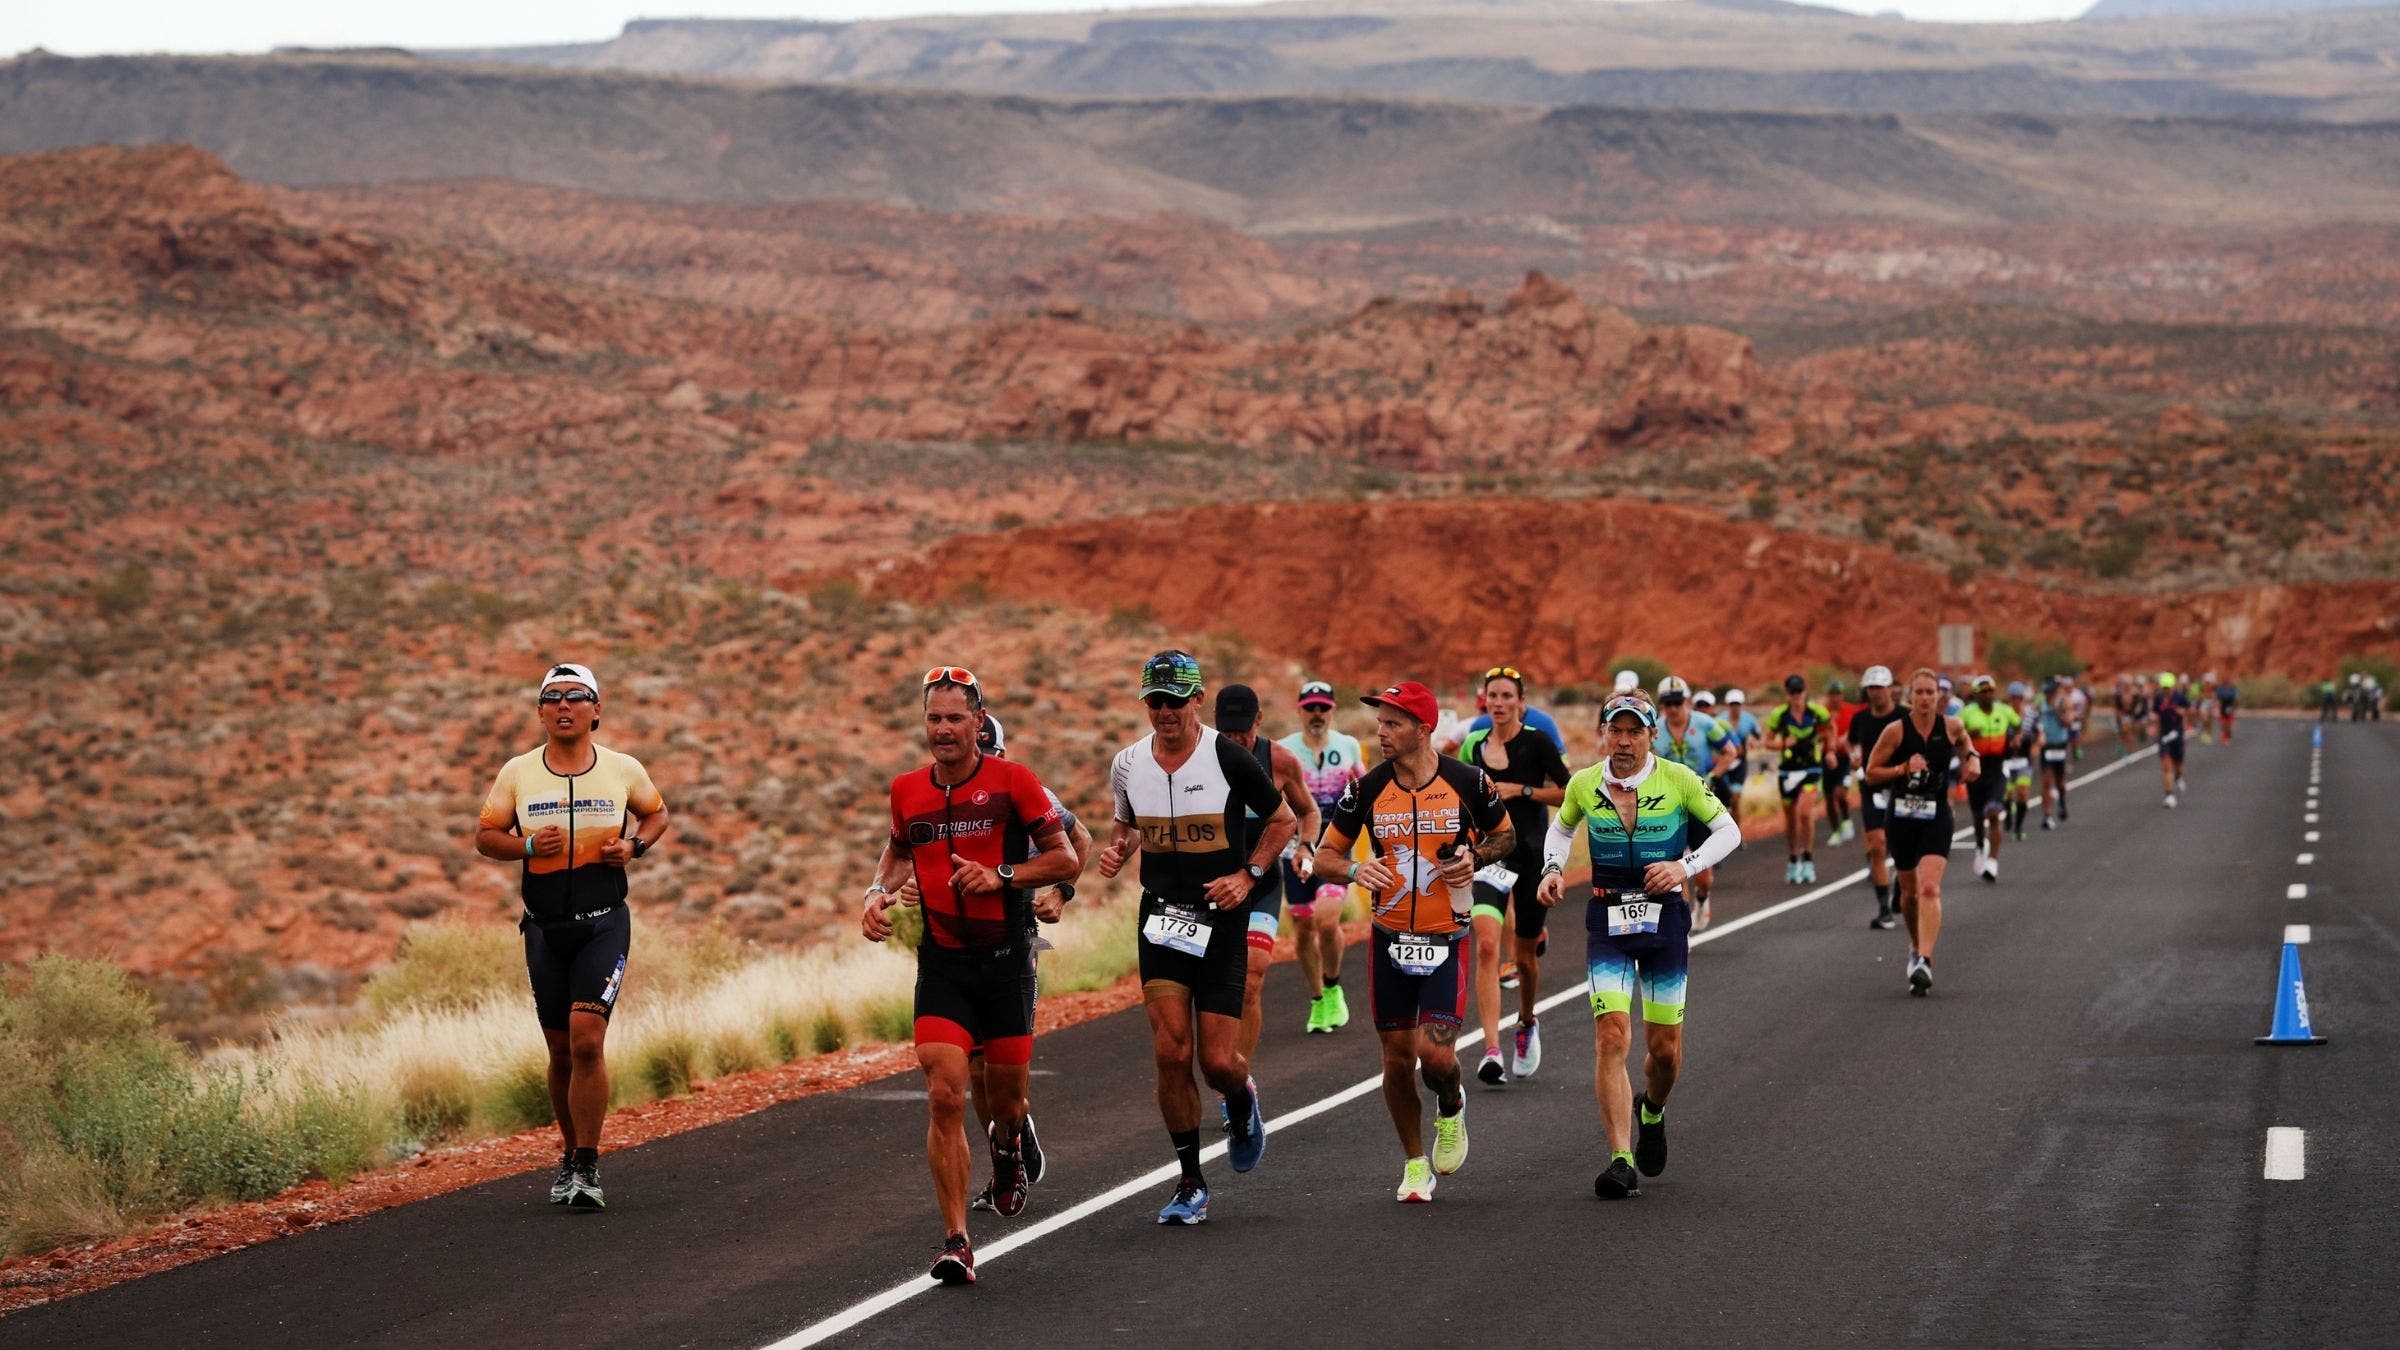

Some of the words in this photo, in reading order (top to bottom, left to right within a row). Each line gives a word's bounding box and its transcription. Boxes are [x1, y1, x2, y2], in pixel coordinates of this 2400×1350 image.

[528, 798, 591, 811] IRONMAN
[593, 800, 615, 808] 70.3
[528, 810, 554, 818] WORLD
[556, 807, 615, 815] CHAMPIONSHIP
[1374, 810, 1430, 823] ZARZAUR
[1433, 808, 1460, 818] LAW
[937, 819, 993, 834] TRIBIKE
[1373, 818, 1461, 839] GAVELS
[937, 829, 993, 840] TRANSPORT
[1160, 917, 1198, 937] 1779
[1395, 946, 1435, 961] 1210
